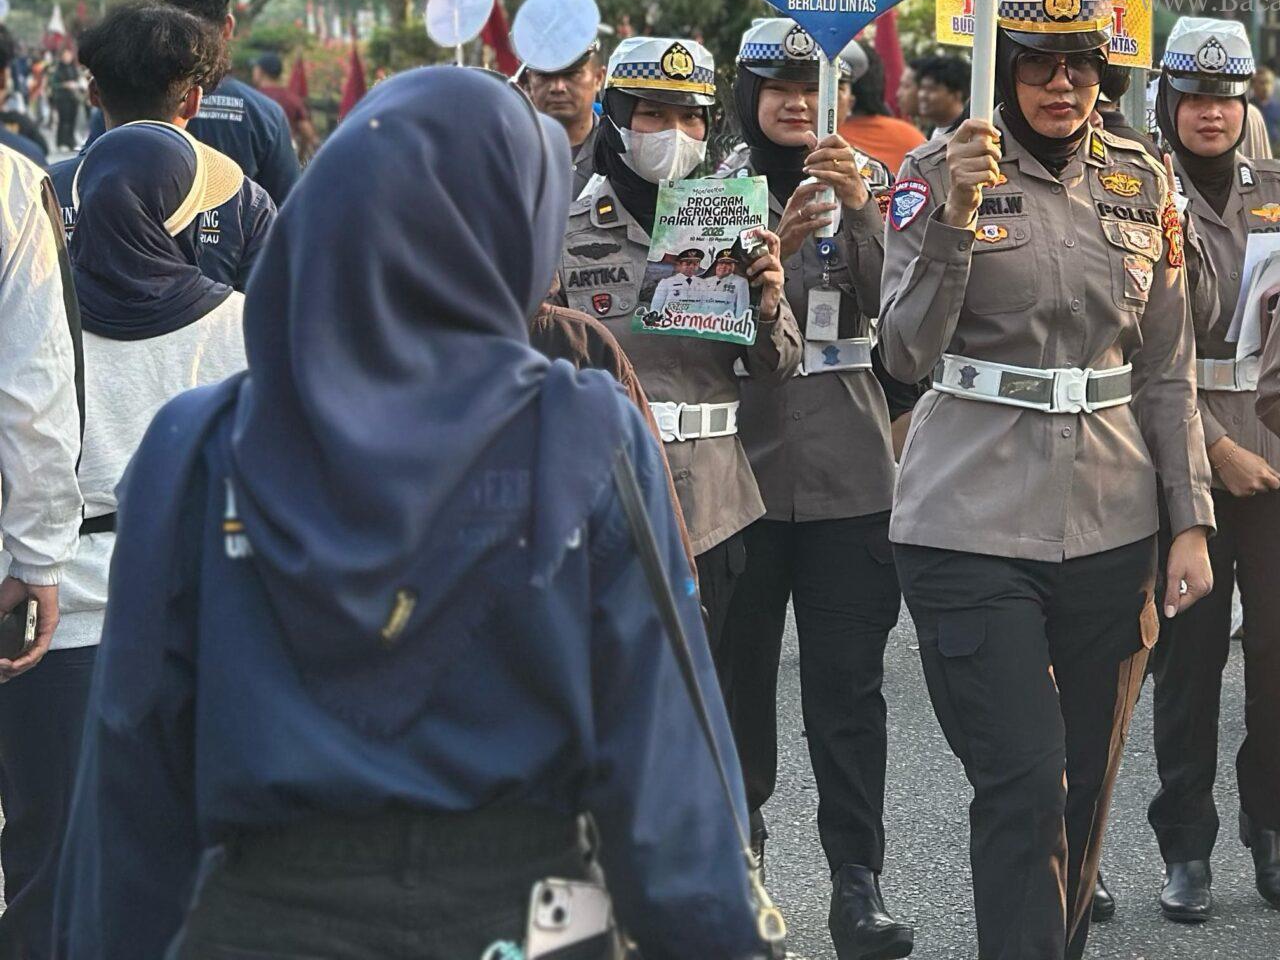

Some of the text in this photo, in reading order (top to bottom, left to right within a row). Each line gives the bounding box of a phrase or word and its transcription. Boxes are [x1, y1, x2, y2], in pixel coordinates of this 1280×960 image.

[1109, 37, 1138, 54] NTAS
[687, 196, 743, 207] PROGRAM
[678, 205, 749, 217] KERINGANAN
[1097, 202, 1160, 226] POLRI
[659, 214, 762, 226] PAJAK KENDARAAN
[568, 266, 629, 287] ARTIKA
